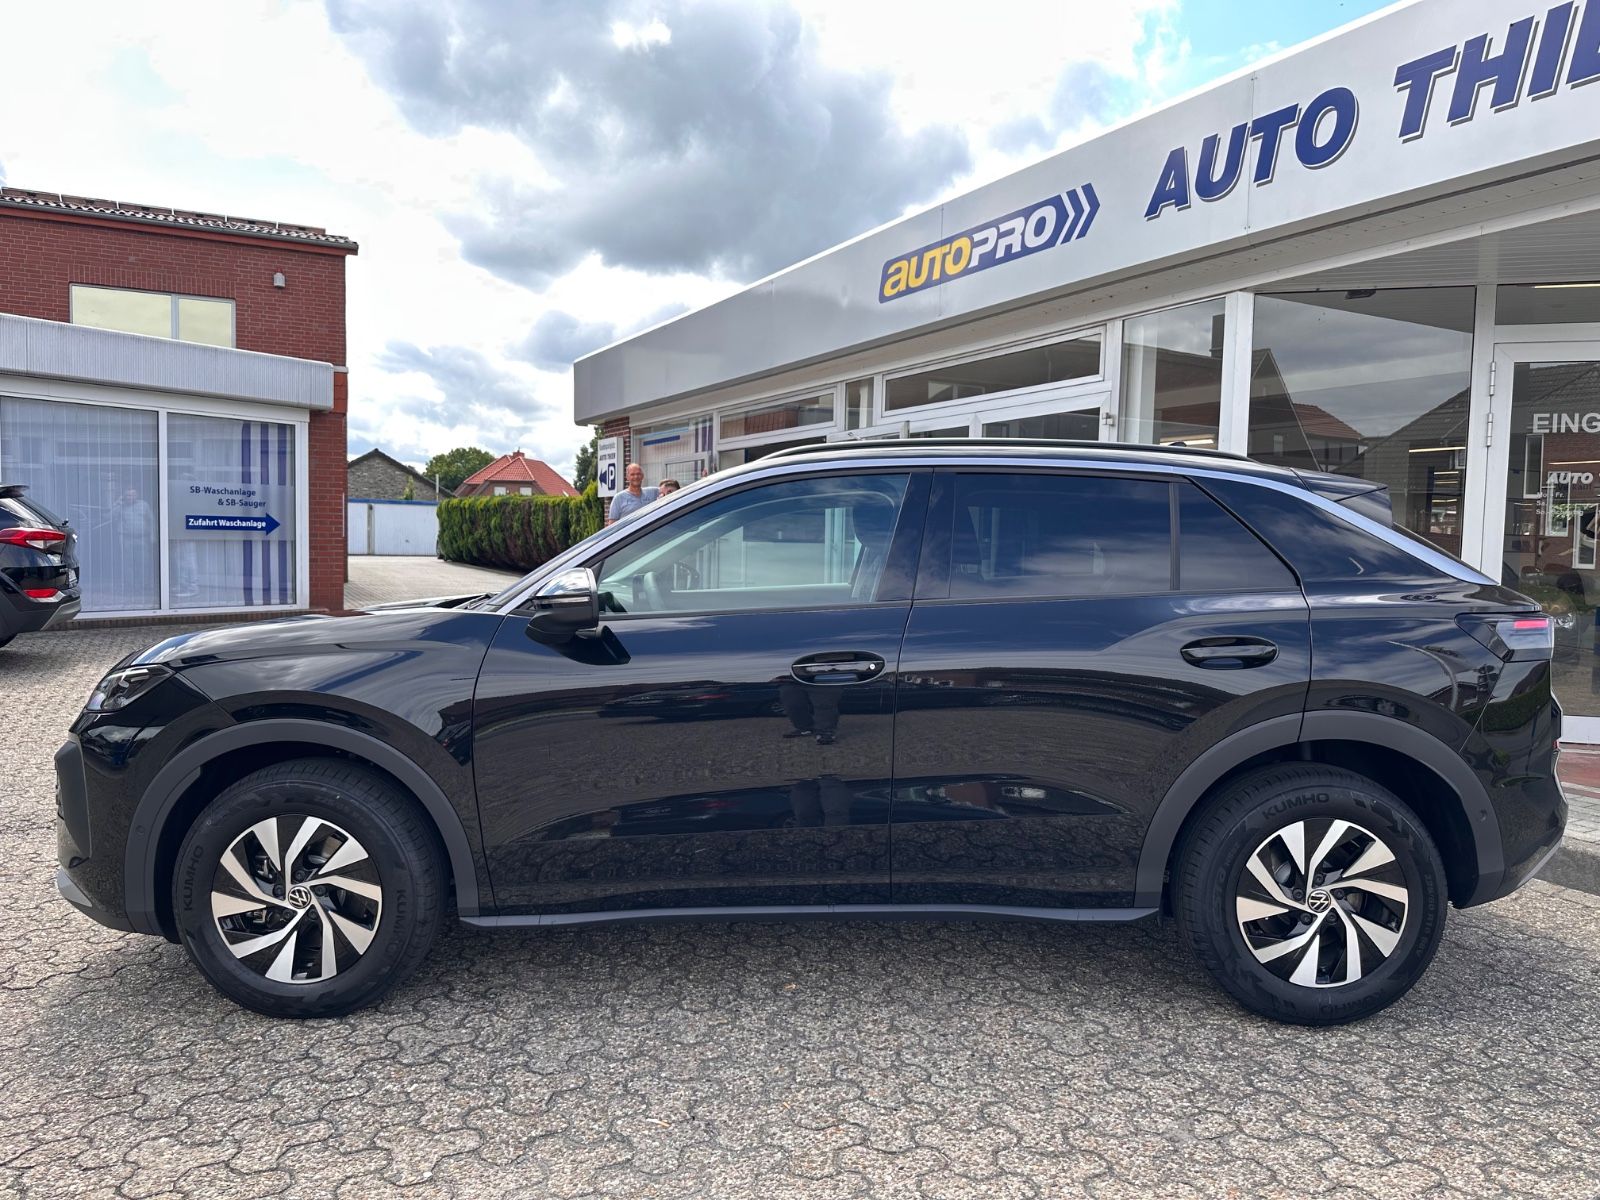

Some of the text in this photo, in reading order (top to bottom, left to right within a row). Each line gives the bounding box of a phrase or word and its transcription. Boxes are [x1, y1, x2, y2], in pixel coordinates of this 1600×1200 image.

[1144, 87, 1358, 220] AUTO
[1532, 413, 1600, 433] EING
[1546, 472, 1593, 484] AUTO
[190, 486, 256, 497] SB-Waschanlage
[217, 498, 266, 508] & SB-Sauger
[188, 518, 266, 529] Zufahrt Waschanlage
[1262, 793, 1330, 820] KUMHO
[184, 845, 204, 911] KUMHO
